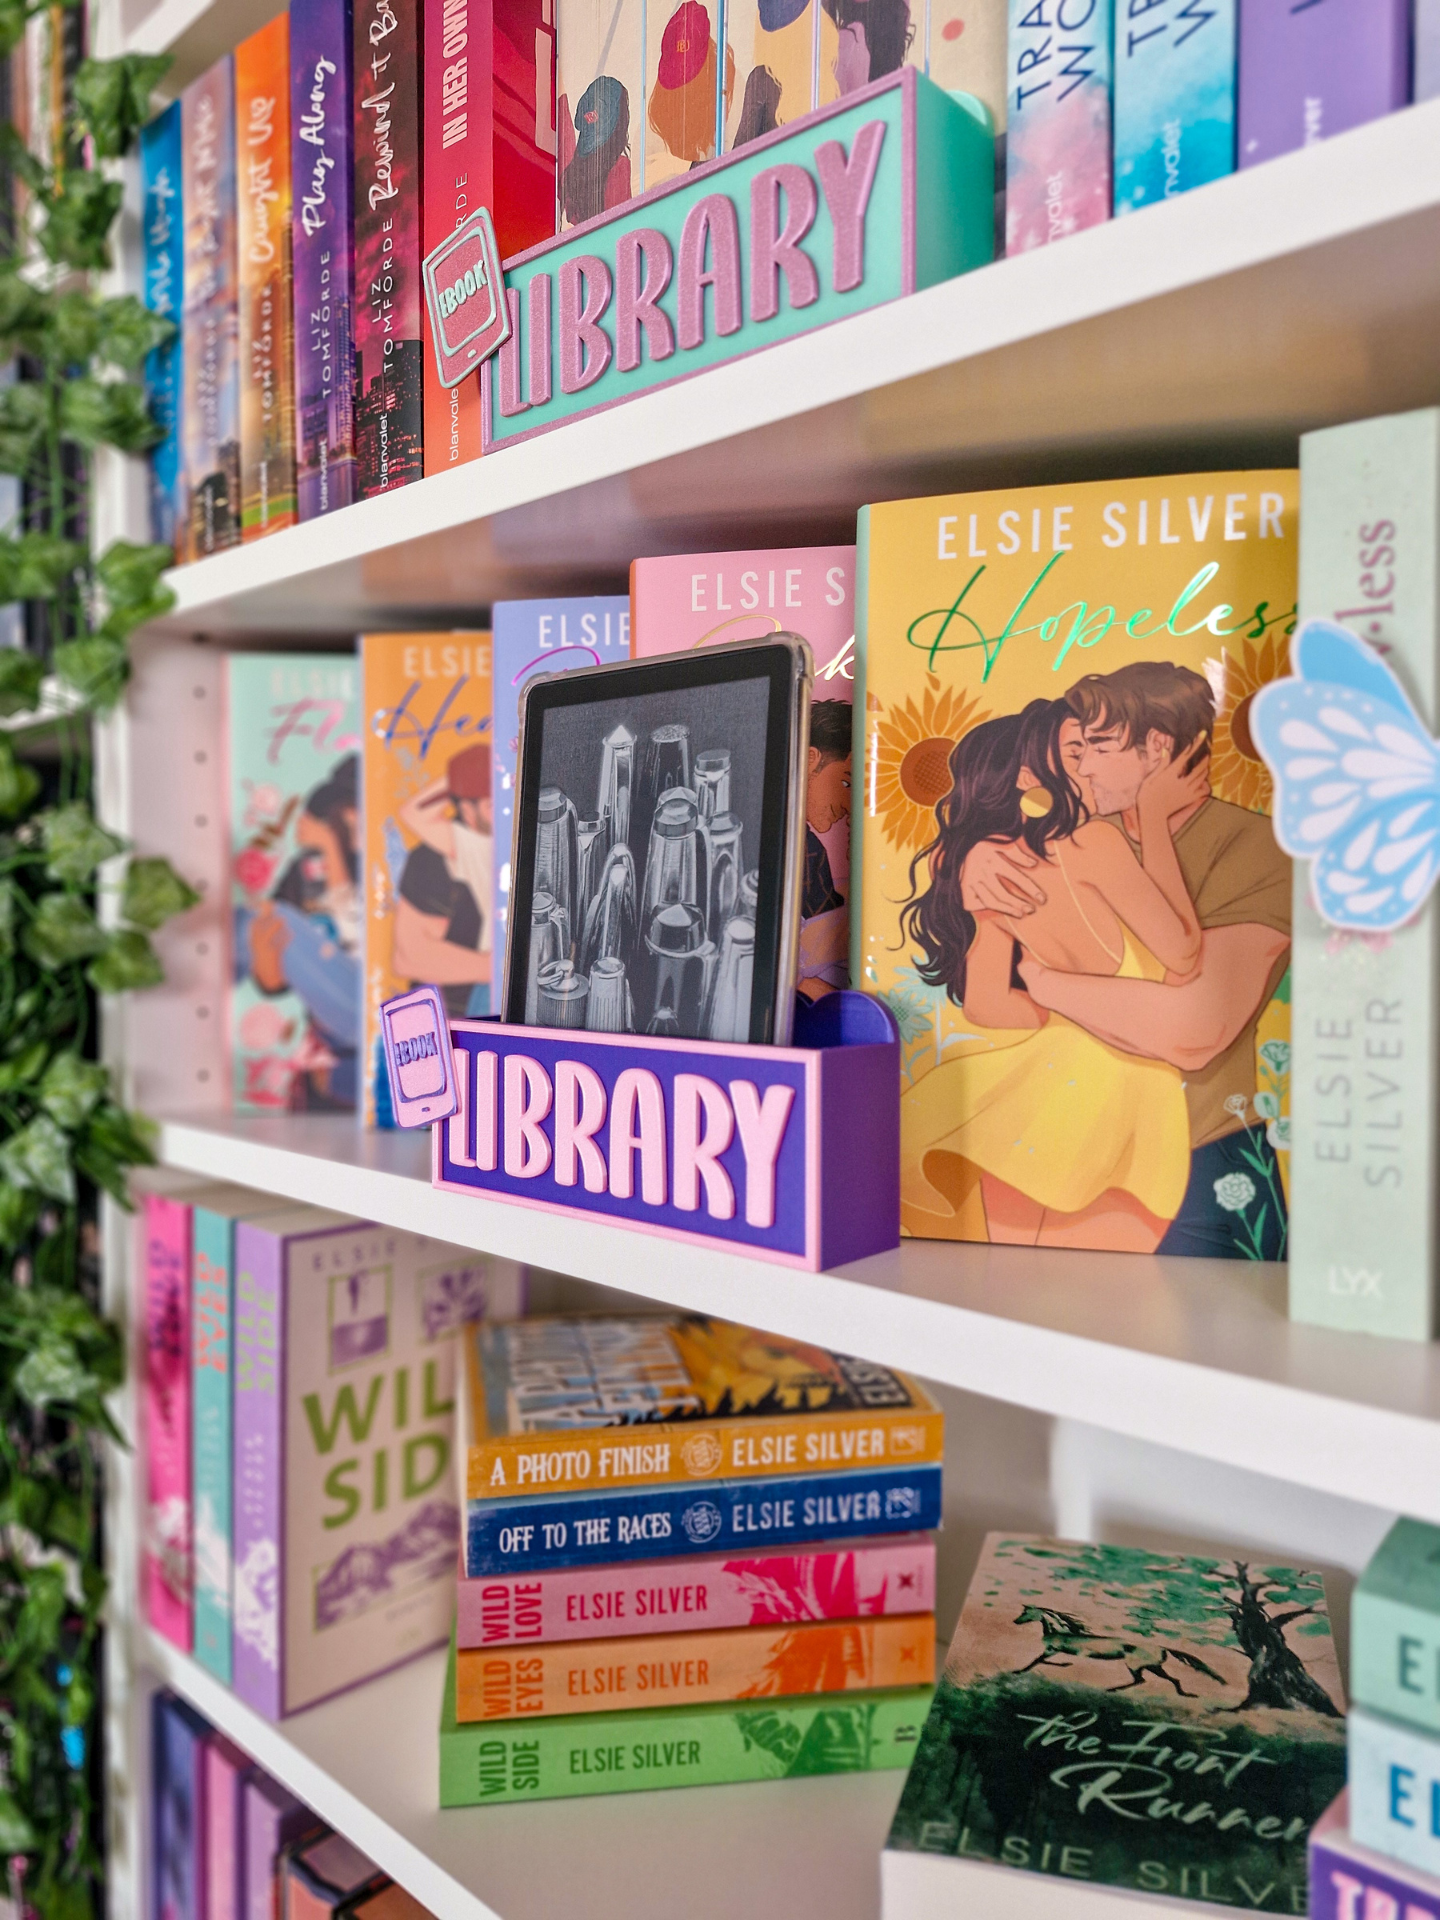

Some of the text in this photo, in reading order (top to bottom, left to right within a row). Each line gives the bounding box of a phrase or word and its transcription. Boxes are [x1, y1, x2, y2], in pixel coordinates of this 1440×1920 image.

[442, 56, 468, 117] HER
[300, 54, 337, 237] Play Along
[362, 82, 398, 211] Rewind
[442, 112, 468, 150] IN
[249, 155, 280, 264] Caught
[383, 217, 394, 374] TOMFORDE
[438, 259, 489, 319] EBOOK
[497, 119, 886, 419] LIBRARY
[311, 308, 322, 352] LIZ
[320, 250, 333, 400] TOMFORDE
[372, 278, 383, 324] LIZ
[380, 413, 392, 490] blanvalet
[937, 492, 1285, 560] ELSIE SILVER
[690, 569, 803, 612] ELSIE
[1315, 1017, 1352, 1164] ELSIE
[1364, 1000, 1403, 1189] SILVER
[448, 1047, 796, 1229] LIBRARY
[490, 1457, 506, 1486] A
[517, 1450, 591, 1484] PHOTO
[598, 1443, 670, 1477] FINISH
[732, 1435, 797, 1467] ELSIE
[805, 1428, 885, 1462] SILVER
[499, 1526, 535, 1553] OFF
[542, 1522, 568, 1549] TO
[573, 1517, 611, 1546] THE
[617, 1512, 672, 1544] RACES
[732, 1500, 795, 1533] ELSIE
[803, 1491, 881, 1525] SILVER
[482, 1585, 510, 1643] WILD
[514, 1582, 542, 1638] LOVE
[566, 1584, 708, 1622] ELSIE SILVER
[483, 1660, 511, 1717] WILD
[515, 1658, 544, 1713] EYES
[567, 1659, 710, 1697] ELSIE SILVER
[479, 1740, 507, 1798] WILD
[512, 1740, 540, 1791] SIDE
[569, 1740, 701, 1775] ELSIE SILVER
[1108, 1720, 1278, 1789] Front
[1049, 1761, 1308, 1842] Runner
[917, 1820, 1094, 1878] ELSIE
